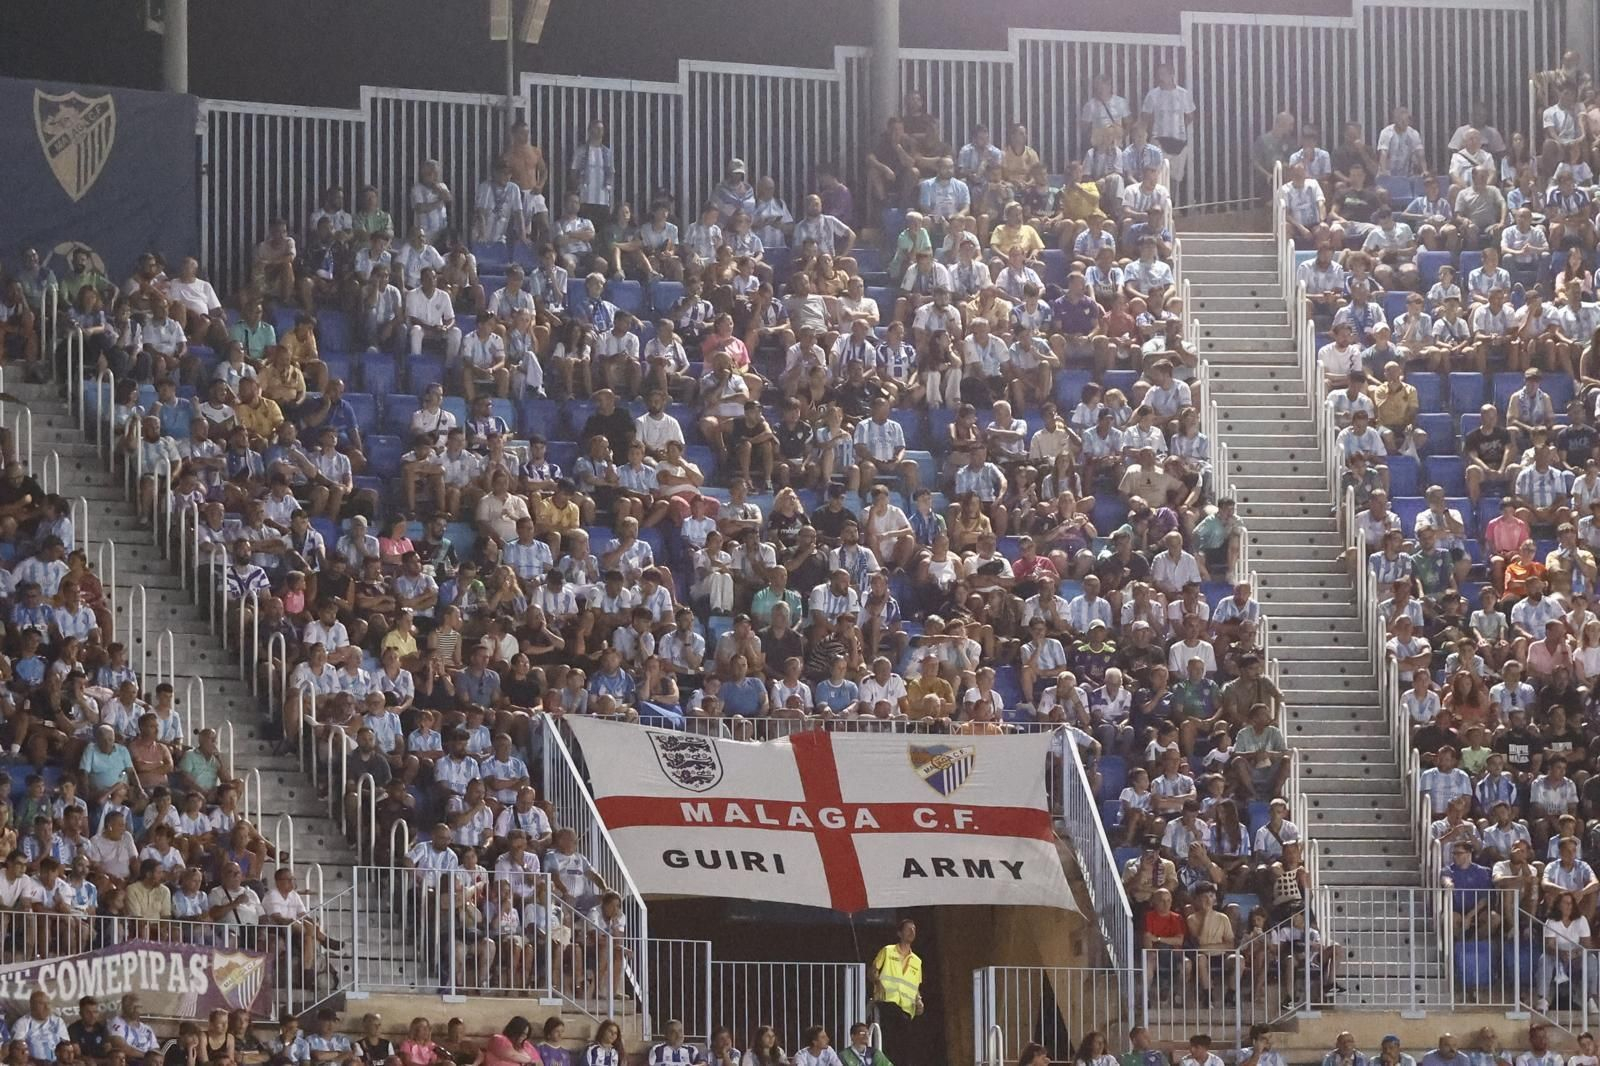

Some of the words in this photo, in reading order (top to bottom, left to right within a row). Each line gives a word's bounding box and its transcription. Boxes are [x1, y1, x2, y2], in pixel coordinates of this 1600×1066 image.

[681, 802, 880, 830] MALAGA
[912, 807, 980, 832] C.F.
[662, 849, 786, 875] GUIRI
[903, 857, 1024, 880] ARMY
[37, 949, 209, 1001] COMEPIPAS
